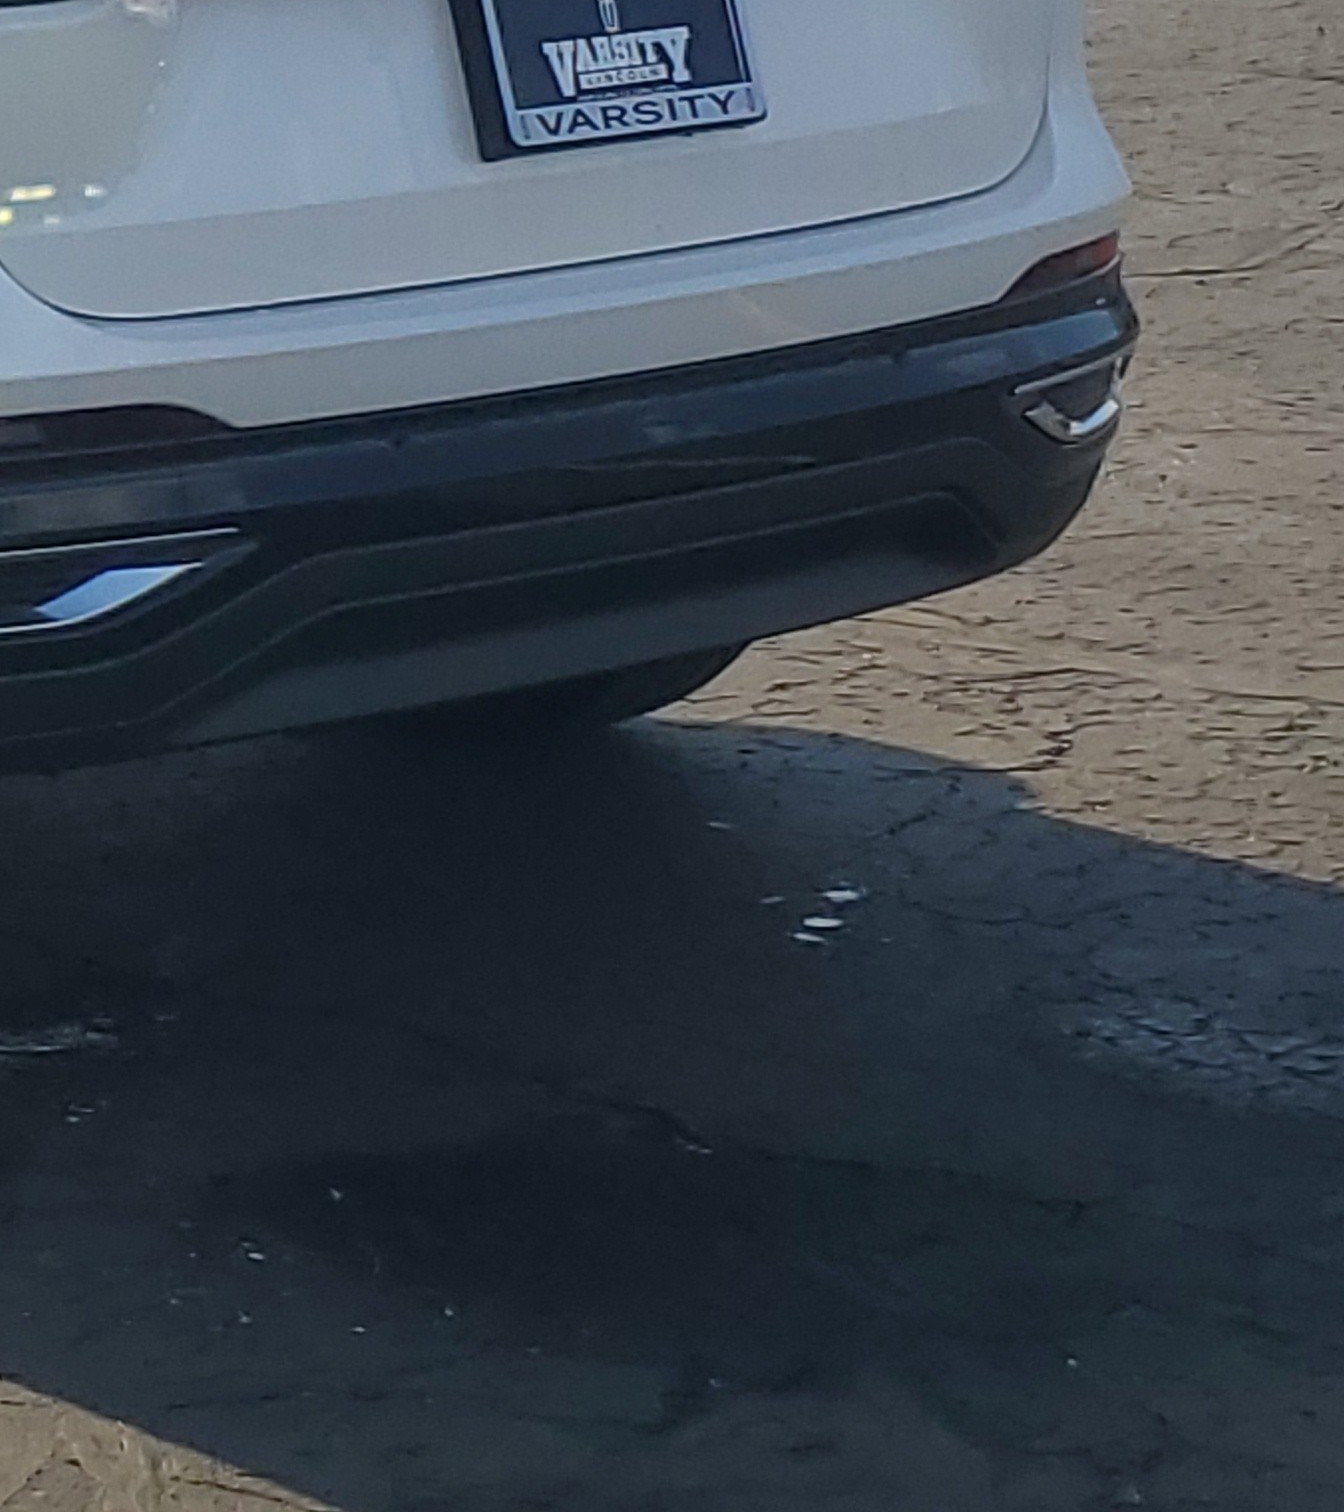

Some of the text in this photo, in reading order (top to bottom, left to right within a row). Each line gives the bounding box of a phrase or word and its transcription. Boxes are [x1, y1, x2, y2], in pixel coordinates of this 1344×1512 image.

[541, 25, 693, 98] VARSITY
[585, 68, 663, 86] LINCOLN
[535, 89, 736, 137] VARSITY
